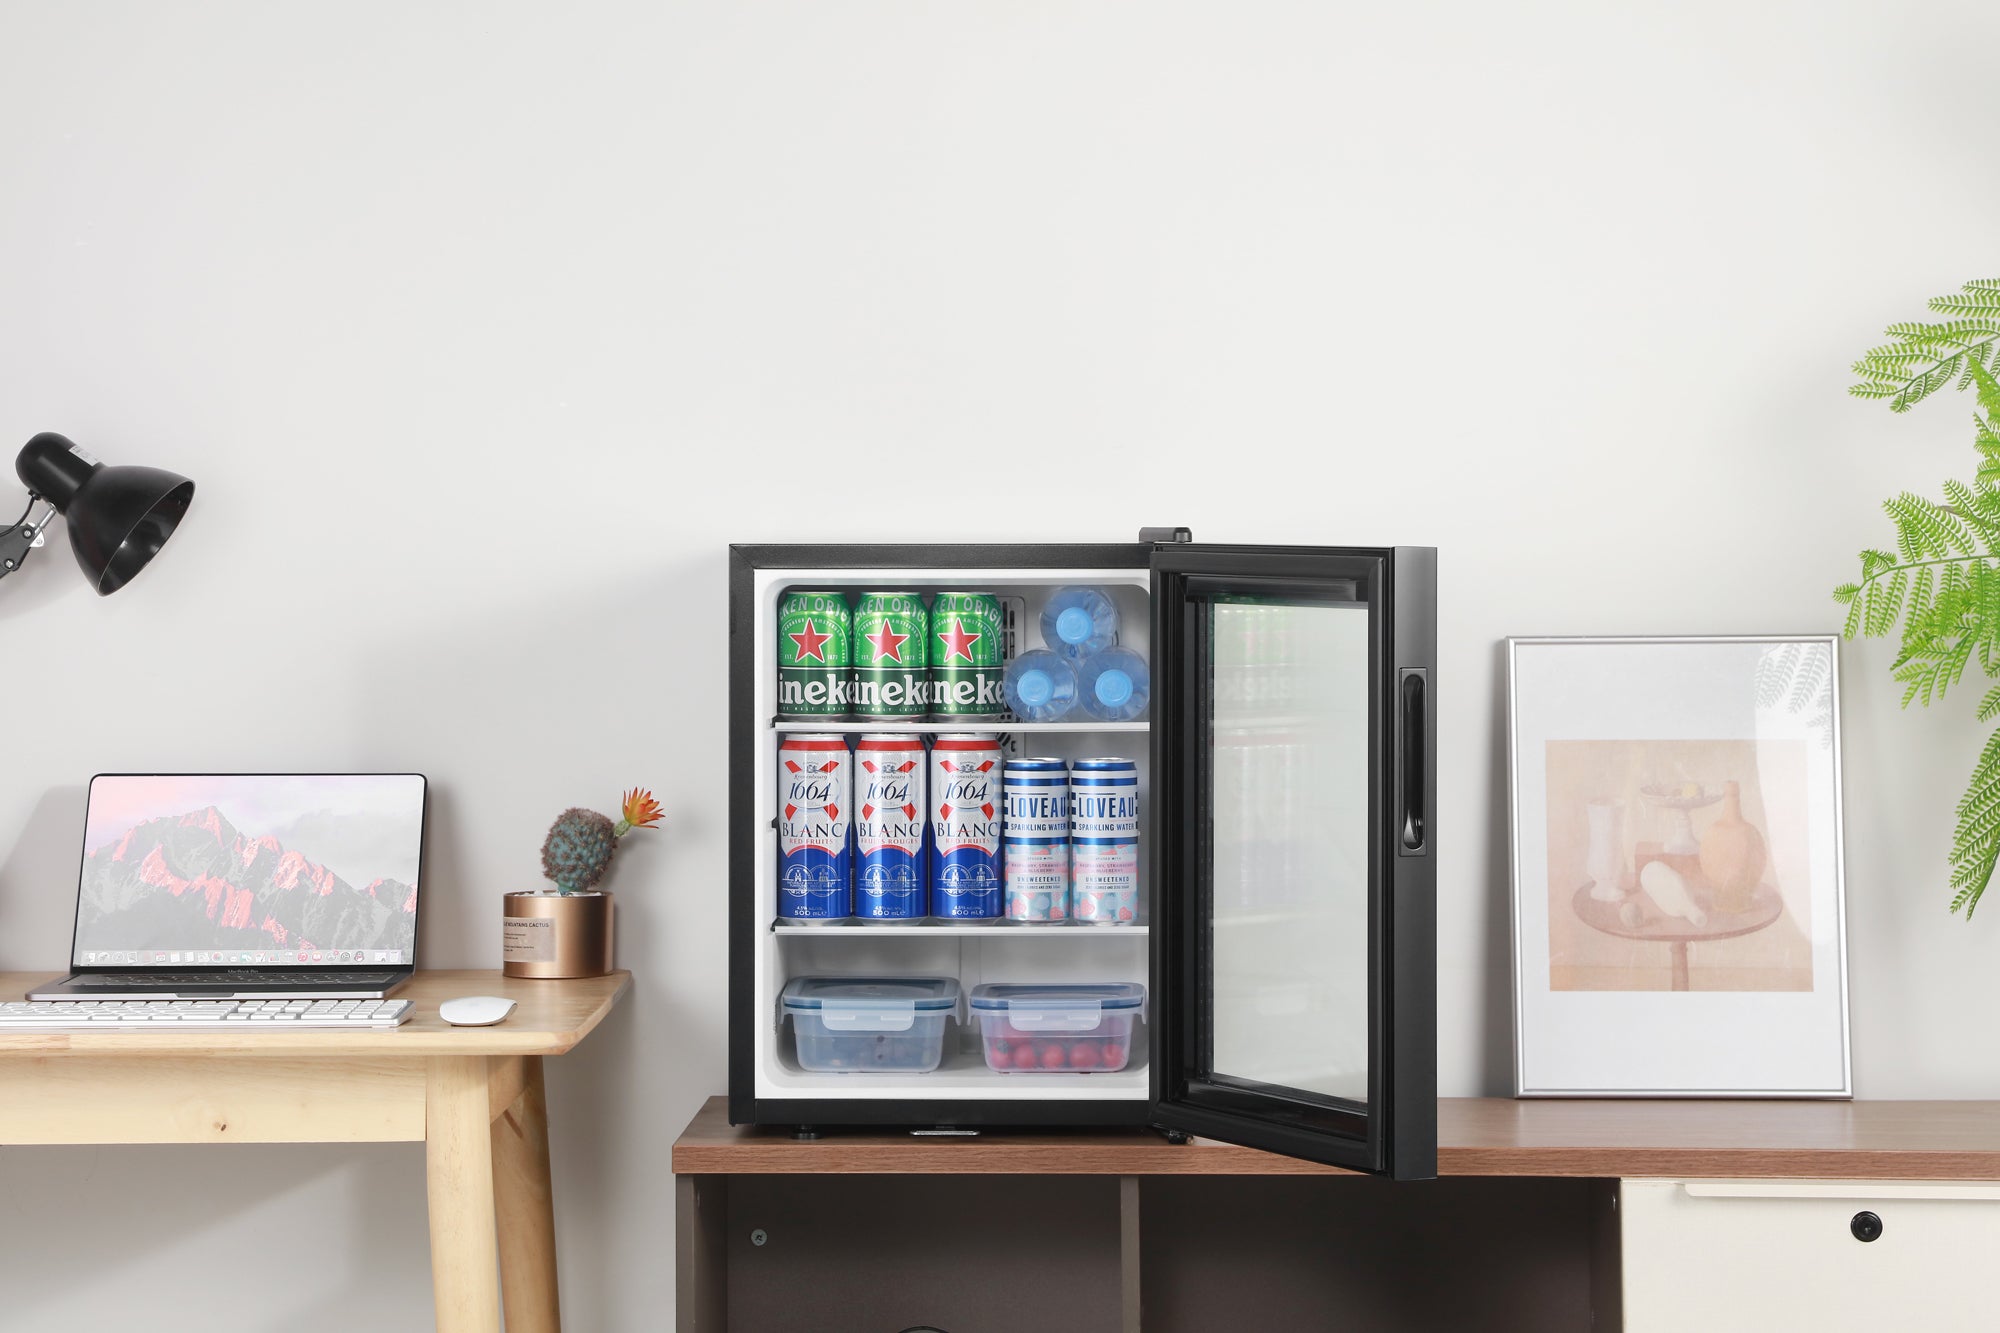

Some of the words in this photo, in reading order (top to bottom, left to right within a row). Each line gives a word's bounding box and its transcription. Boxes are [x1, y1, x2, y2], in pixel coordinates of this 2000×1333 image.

[789, 781, 831, 801] 1664
[867, 780, 911, 801] 1664
[945, 780, 990, 801] 1664
[1011, 797, 1066, 818] LOVEAU
[1079, 797, 1134, 818] LOVEAU
[782, 823, 843, 838] BLANC
[859, 823, 920, 838] BLANC
[937, 822, 998, 837] BLANC
[1048, 823, 1066, 831] WATER
[1117, 823, 1134, 831] WATER
